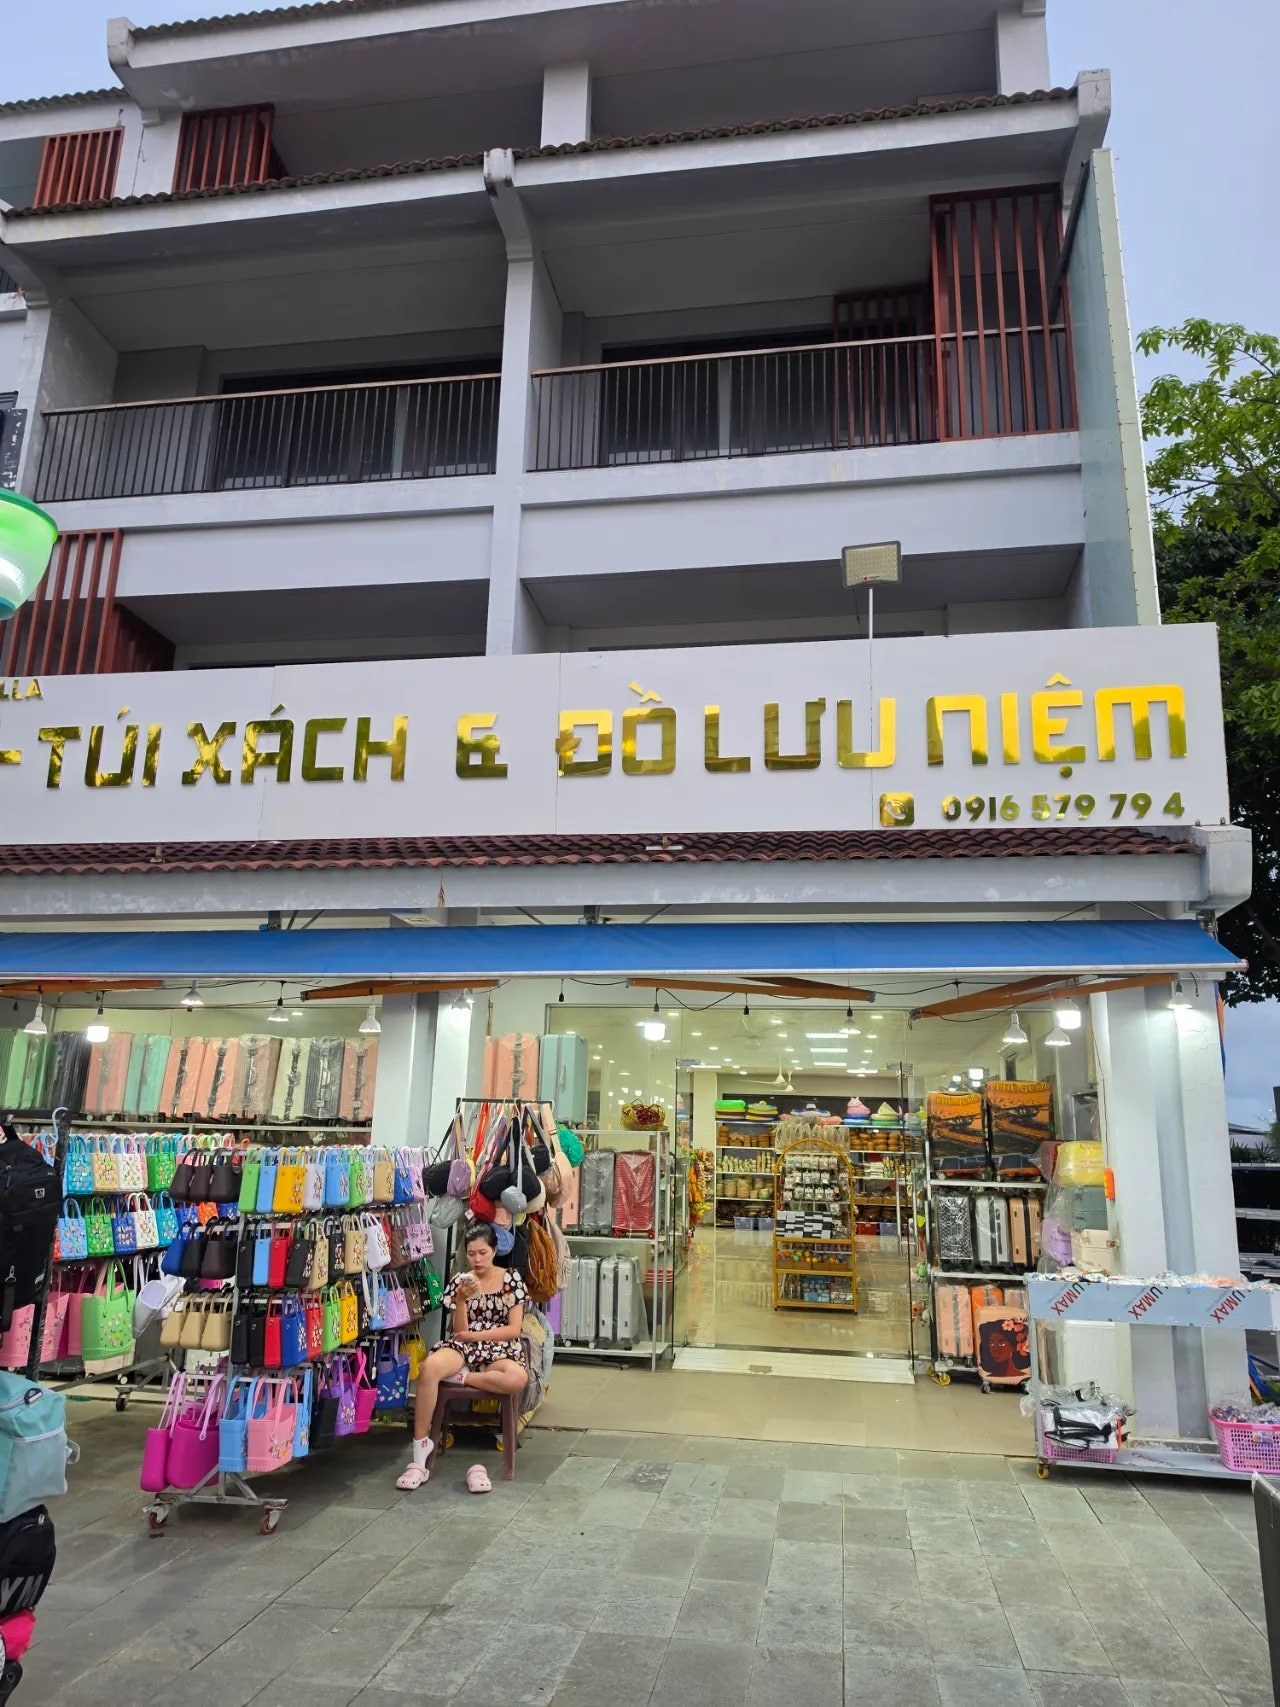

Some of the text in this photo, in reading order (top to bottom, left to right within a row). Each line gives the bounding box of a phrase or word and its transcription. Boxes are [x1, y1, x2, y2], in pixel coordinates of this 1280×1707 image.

[38, 705, 162, 788] TÚI
[181, 703, 408, 785] XÁCH
[456, 712, 508, 779] &
[555, 680, 676, 776] ĐỒ
[704, 697, 896, 772] LƯU
[926, 672, 1188, 779] NIỆM
[941, 794, 1020, 822] 0916
[1031, 794, 1096, 821] 579
[1050, 1281, 1090, 1316] UMAX
[1128, 1285, 1168, 1320] UMAX
[1210, 1289, 1251, 1324] UMAX
